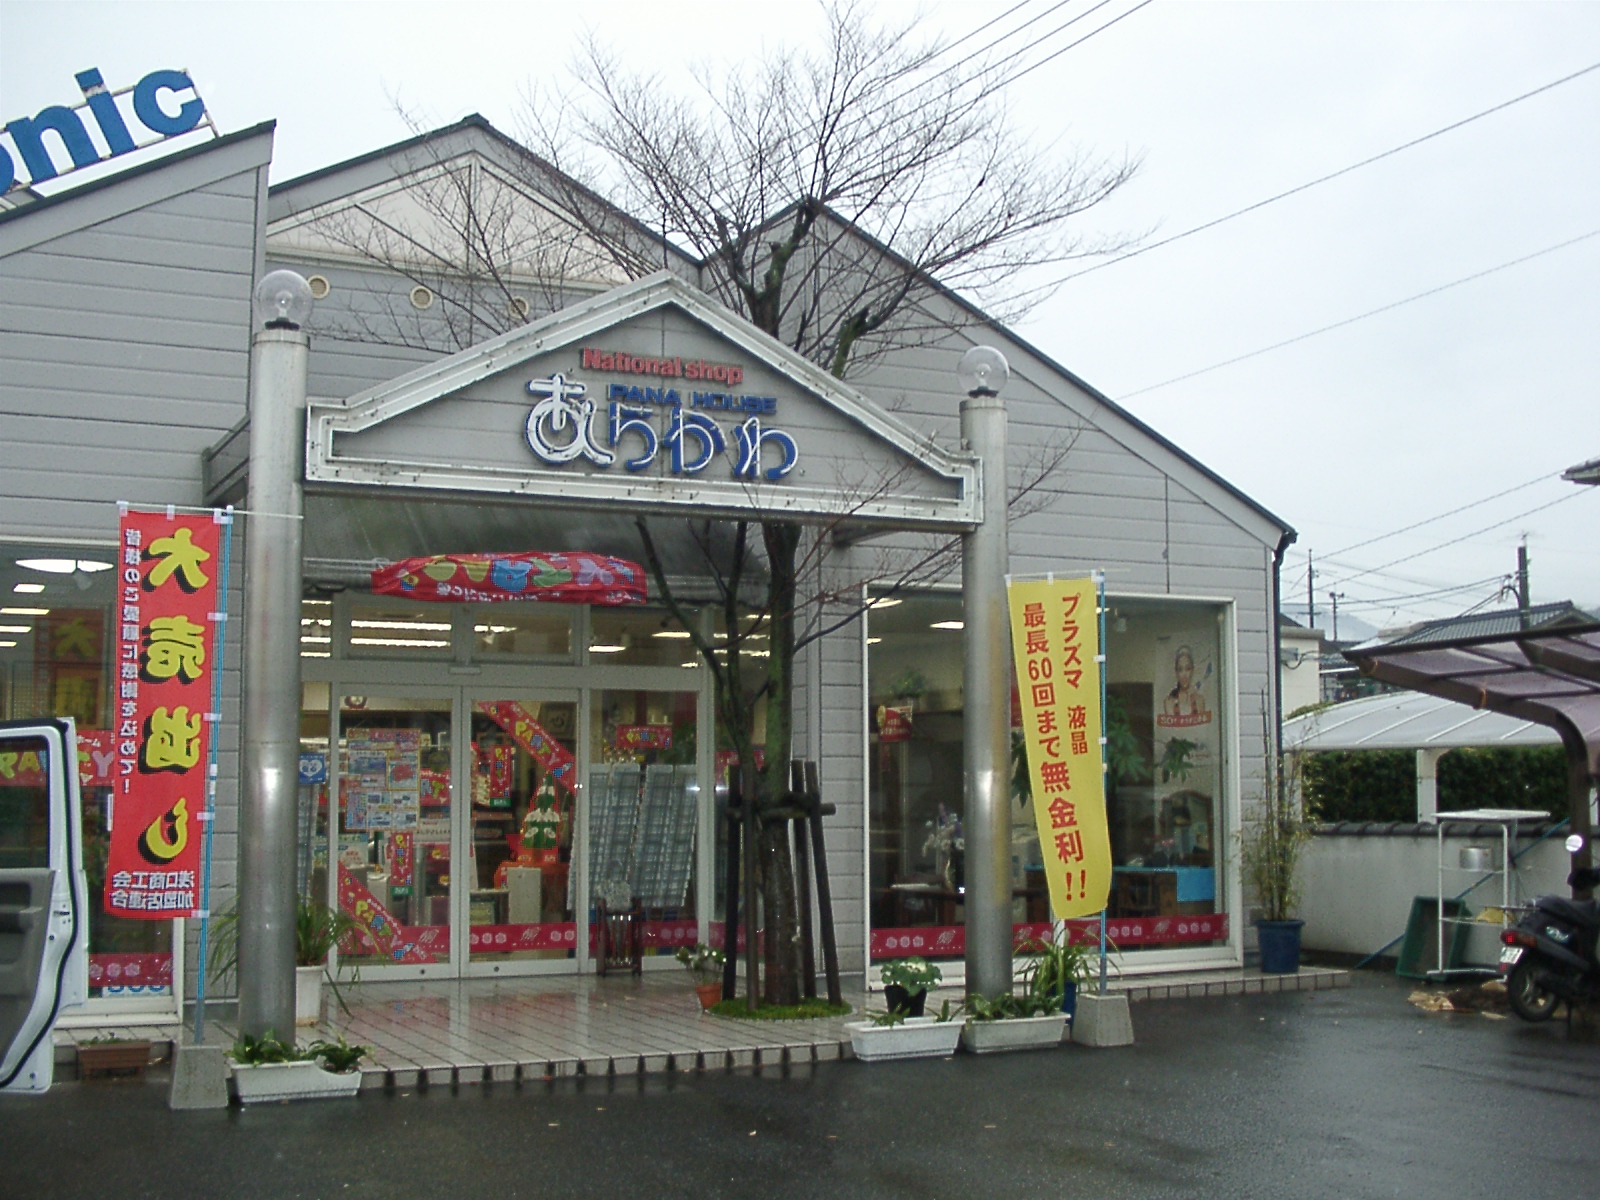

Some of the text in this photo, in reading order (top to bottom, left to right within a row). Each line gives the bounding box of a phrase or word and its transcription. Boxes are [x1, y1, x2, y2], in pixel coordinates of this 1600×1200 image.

[0, 67, 205, 197] nic
[582, 348, 744, 385] National shop
[608, 384, 778, 415] PANA HOUSE
[526, 372, 799, 481] あらかわ
[1062, 592, 1089, 755] プラズマ 液晶
